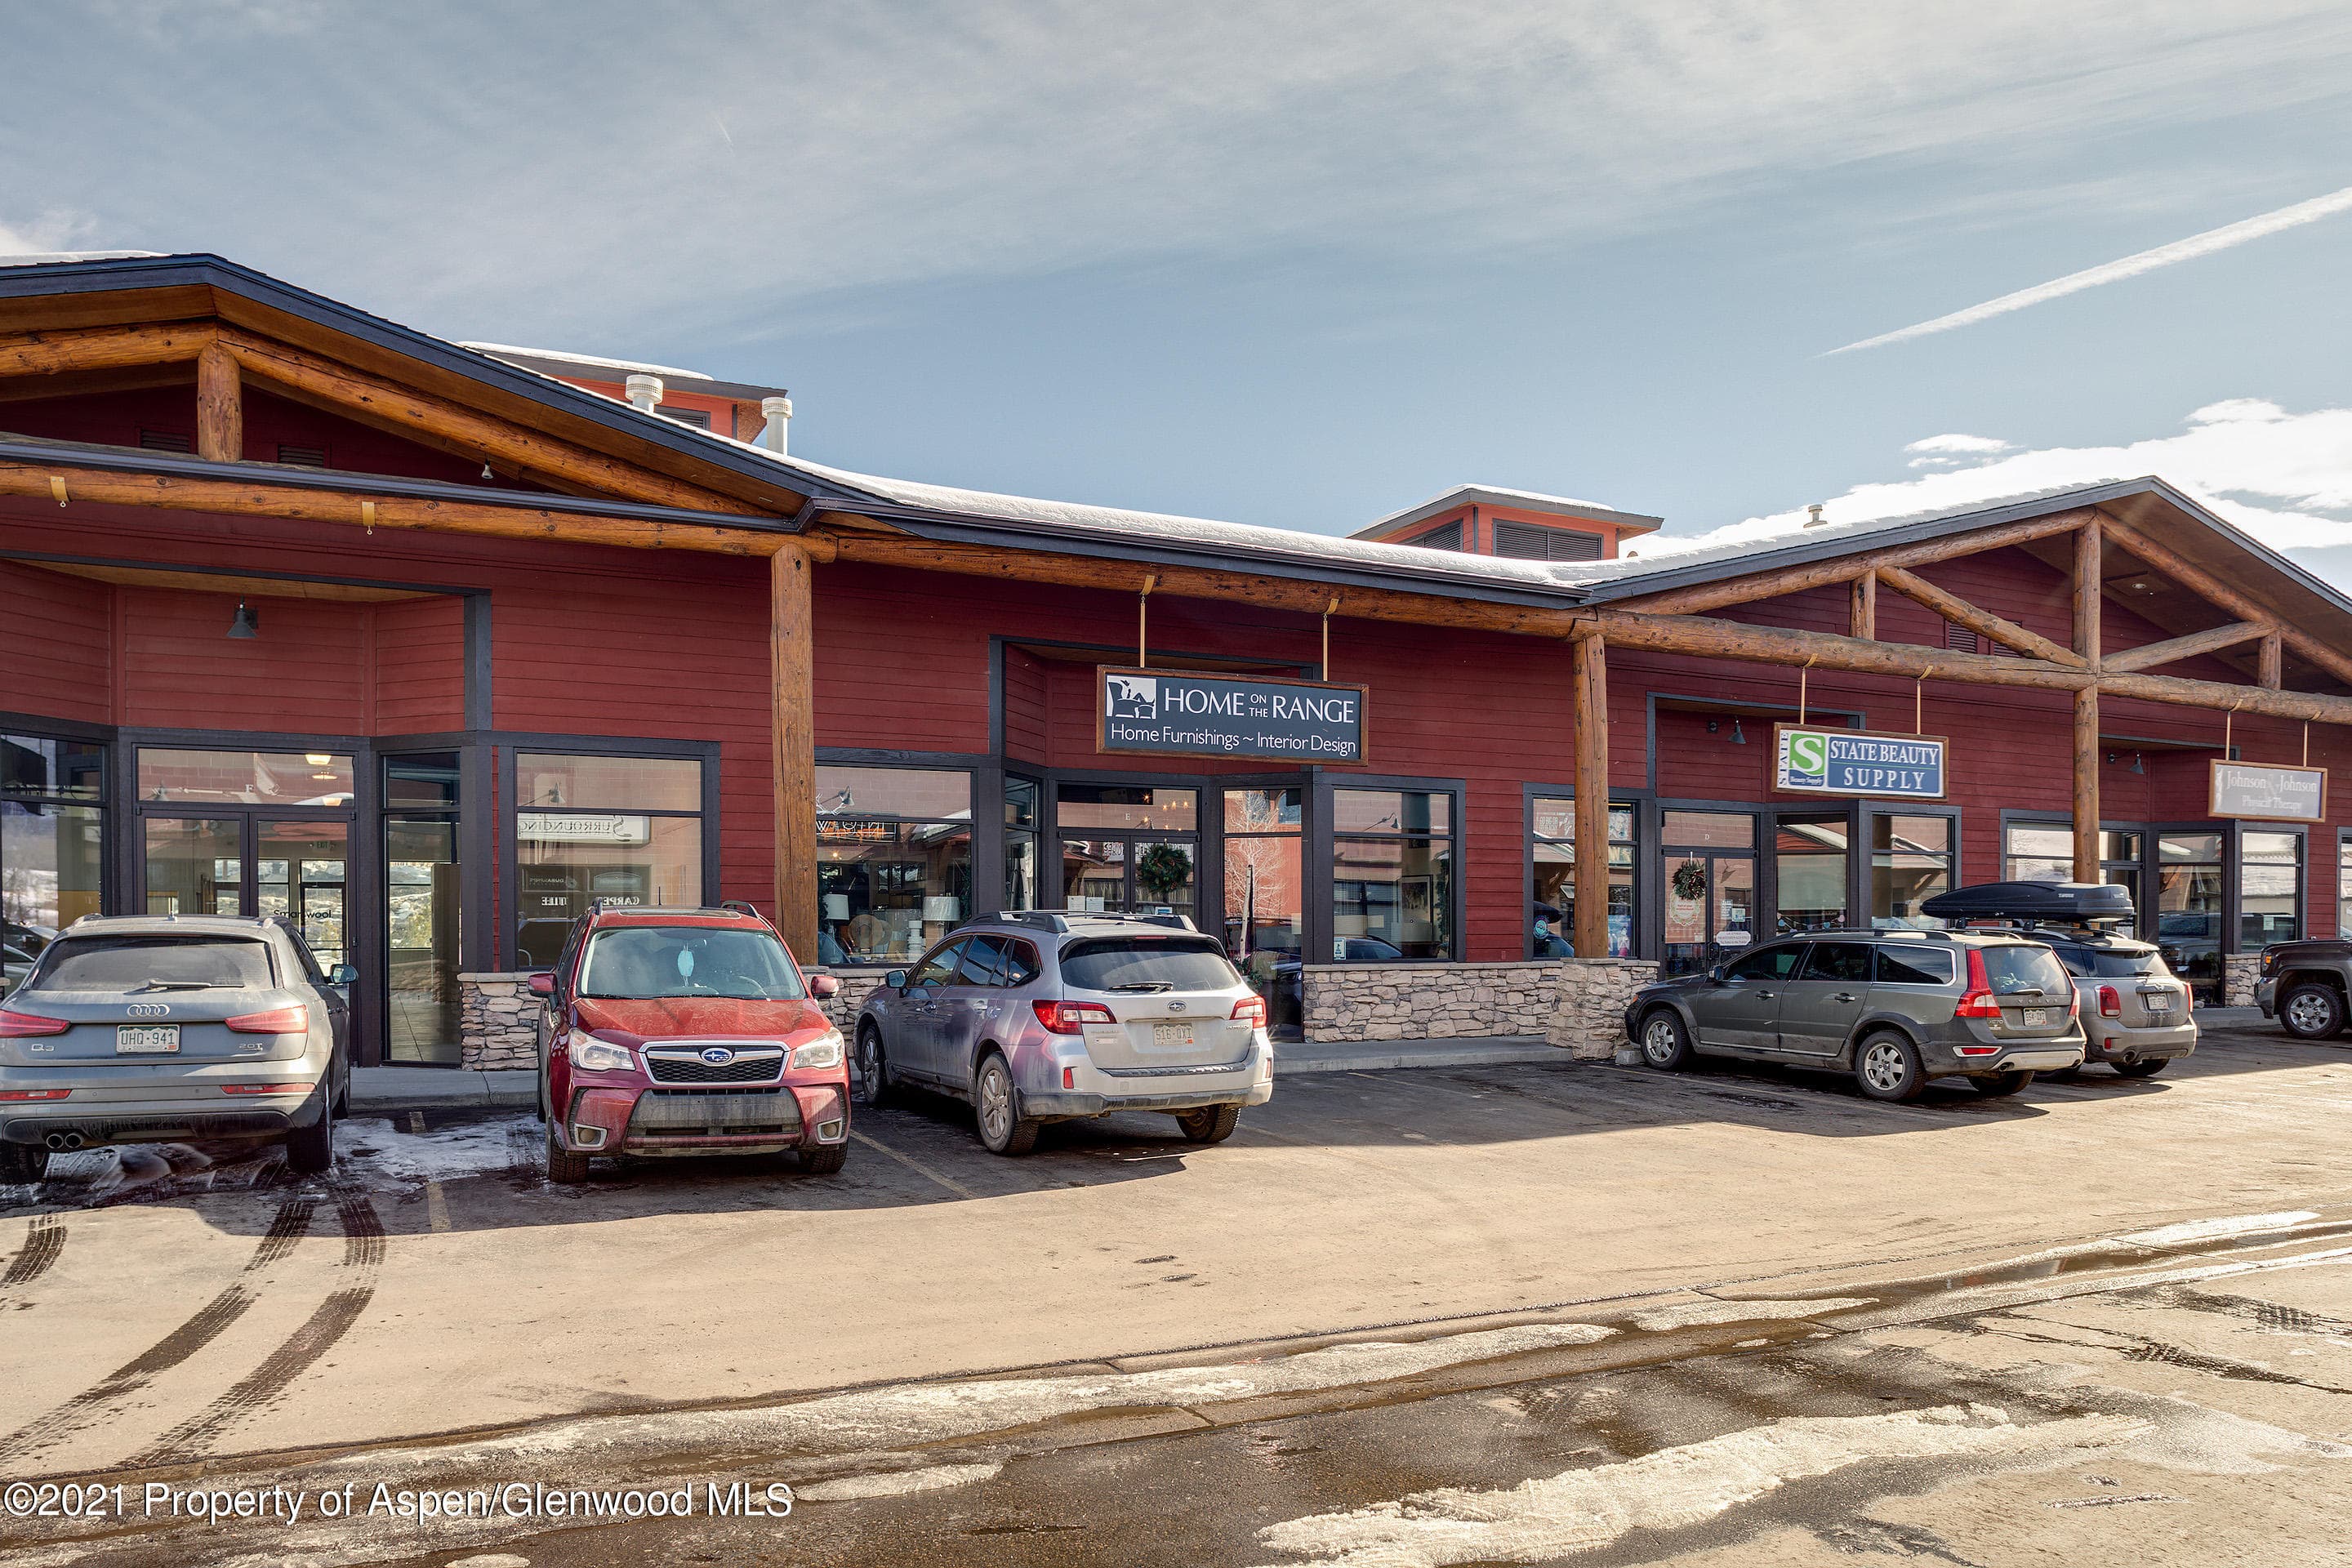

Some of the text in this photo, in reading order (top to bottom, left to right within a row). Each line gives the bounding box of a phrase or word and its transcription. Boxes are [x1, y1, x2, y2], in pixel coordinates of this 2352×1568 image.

[1165, 688, 1354, 724] HOME ON THE RANGE
[1111, 723, 1160, 742] Home
[1163, 726, 1240, 751] Furnishings
[1257, 732, 1308, 750] Interior
[1311, 735, 1356, 756] Design
[1830, 740, 1939, 765] STATE BEAUTY
[1843, 767, 1926, 790] SUPPLY
[2227, 770, 2266, 790] Johnson
[2279, 775, 2318, 793] Johnson
[1125, 813, 1131, 821] E
[274, 909, 332, 920] Smarwool
